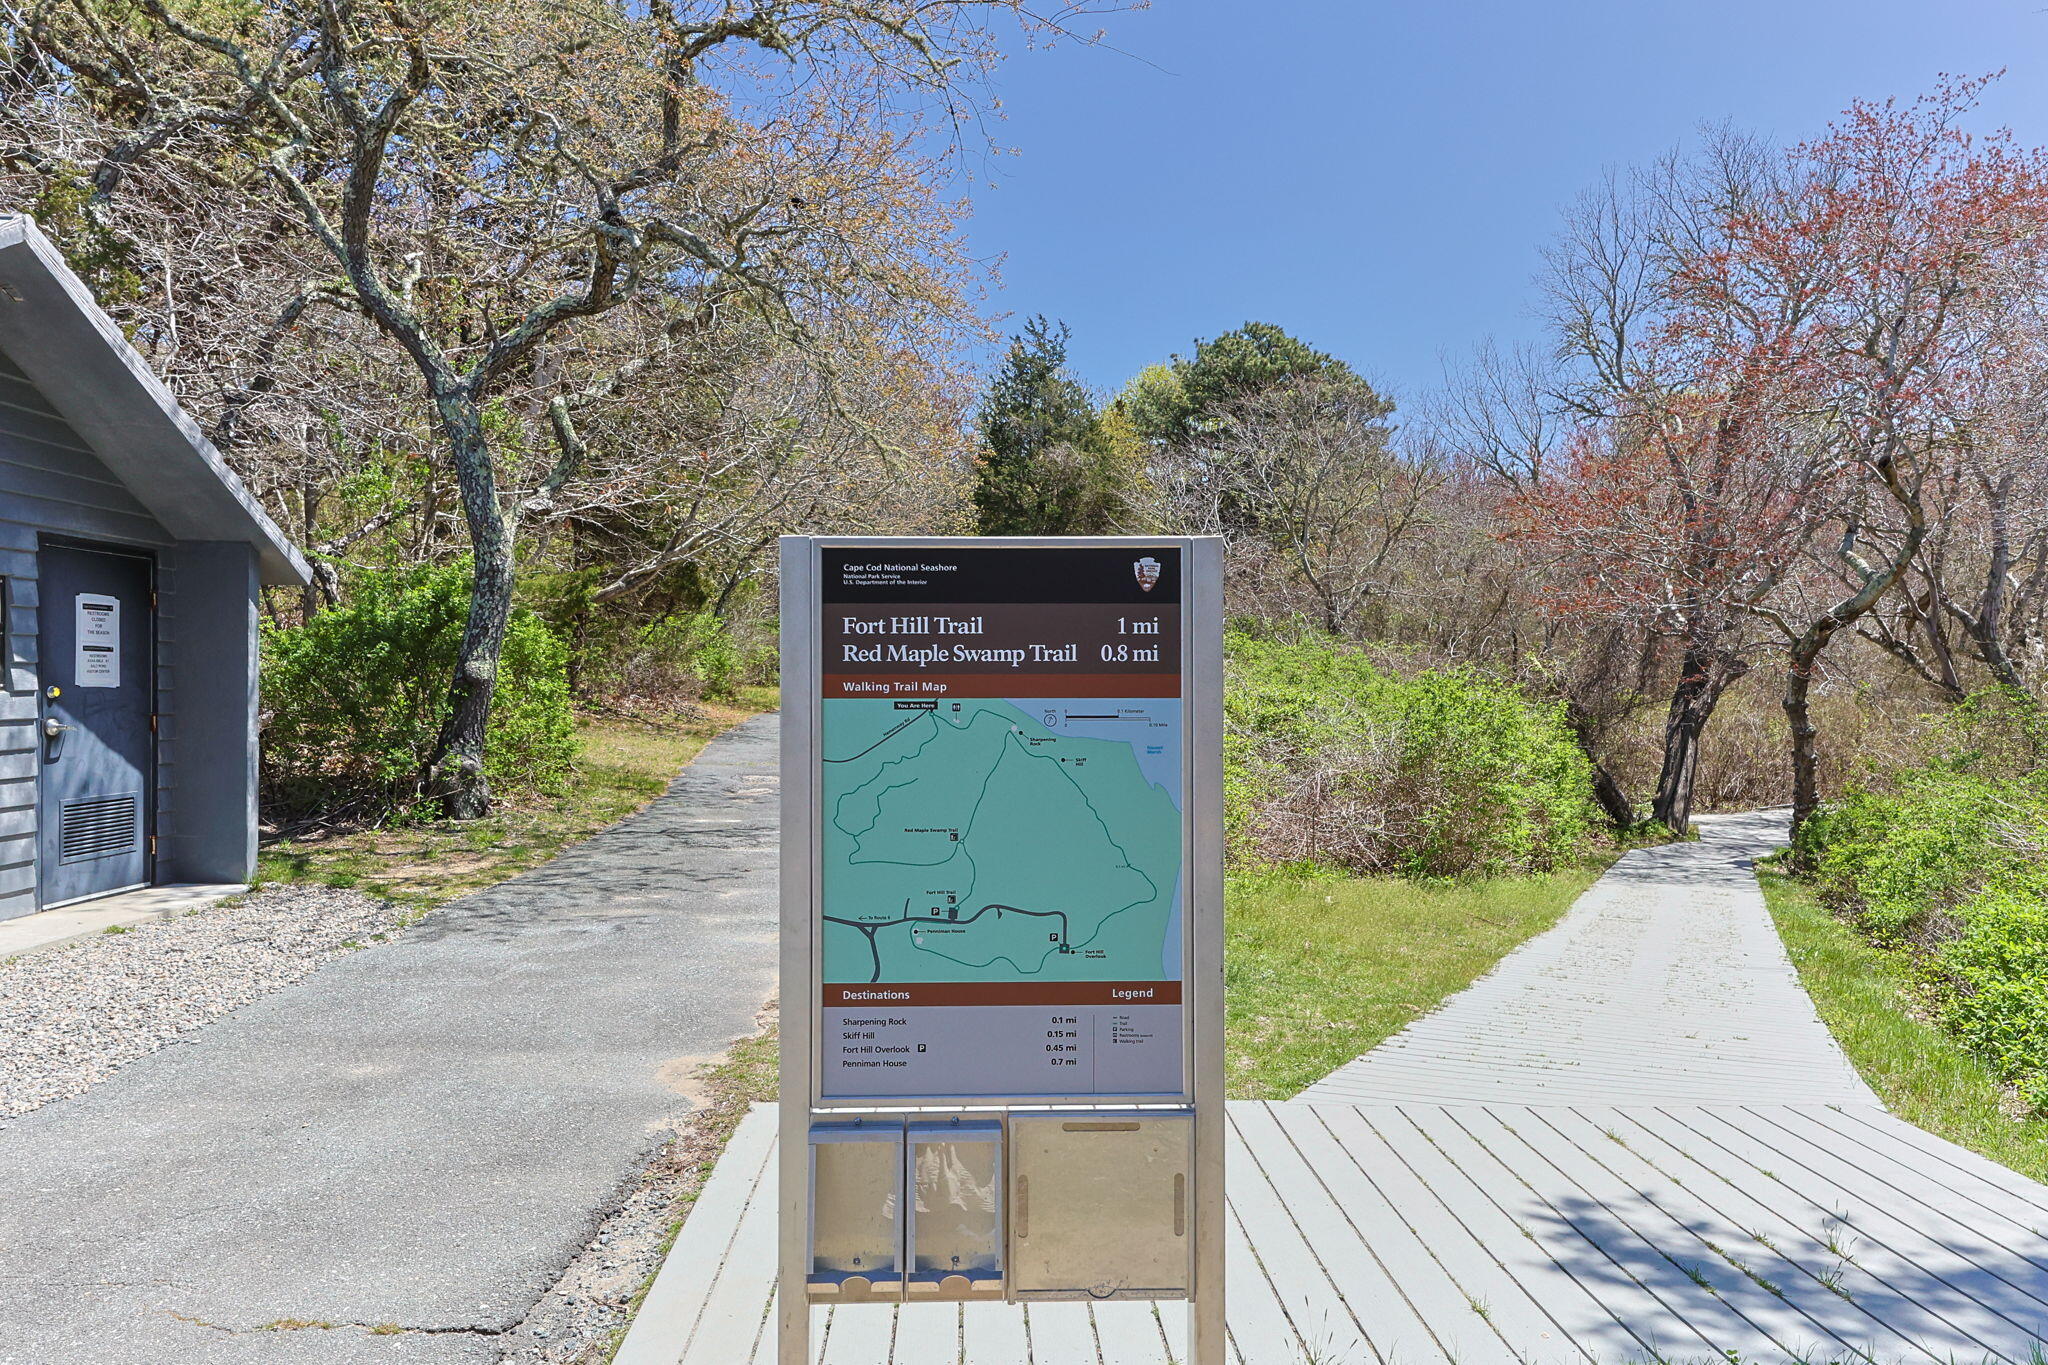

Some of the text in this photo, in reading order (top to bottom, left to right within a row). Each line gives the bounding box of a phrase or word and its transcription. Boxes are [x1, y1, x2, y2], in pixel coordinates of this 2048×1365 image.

[843, 563, 958, 572] Cape Cod National Seashore
[842, 616, 984, 635] Fort Hill Trail
[1117, 617, 1160, 635] 1 mi
[842, 644, 1078, 668] Red Maple Swamp Trail
[1100, 644, 1160, 662] 0.8 mi
[843, 682, 947, 693] Walking Trail Map
[842, 990, 910, 1000] Destinations
[1112, 988, 1153, 999] Legend
[843, 1018, 907, 1027] Sharpening Rock
[1051, 1016, 1077, 1024] 0.1 mi
[842, 1032, 861, 1040] Skiff
[1047, 1030, 1064, 1038] 0.15
[842, 1046, 859, 1054] Fort
[875, 1045, 910, 1054] Overlook
[1045, 1044, 1077, 1052] 0.45 mi
[842, 1060, 881, 1068] Penniman
[1051, 1058, 1077, 1066] 0.7 mi
